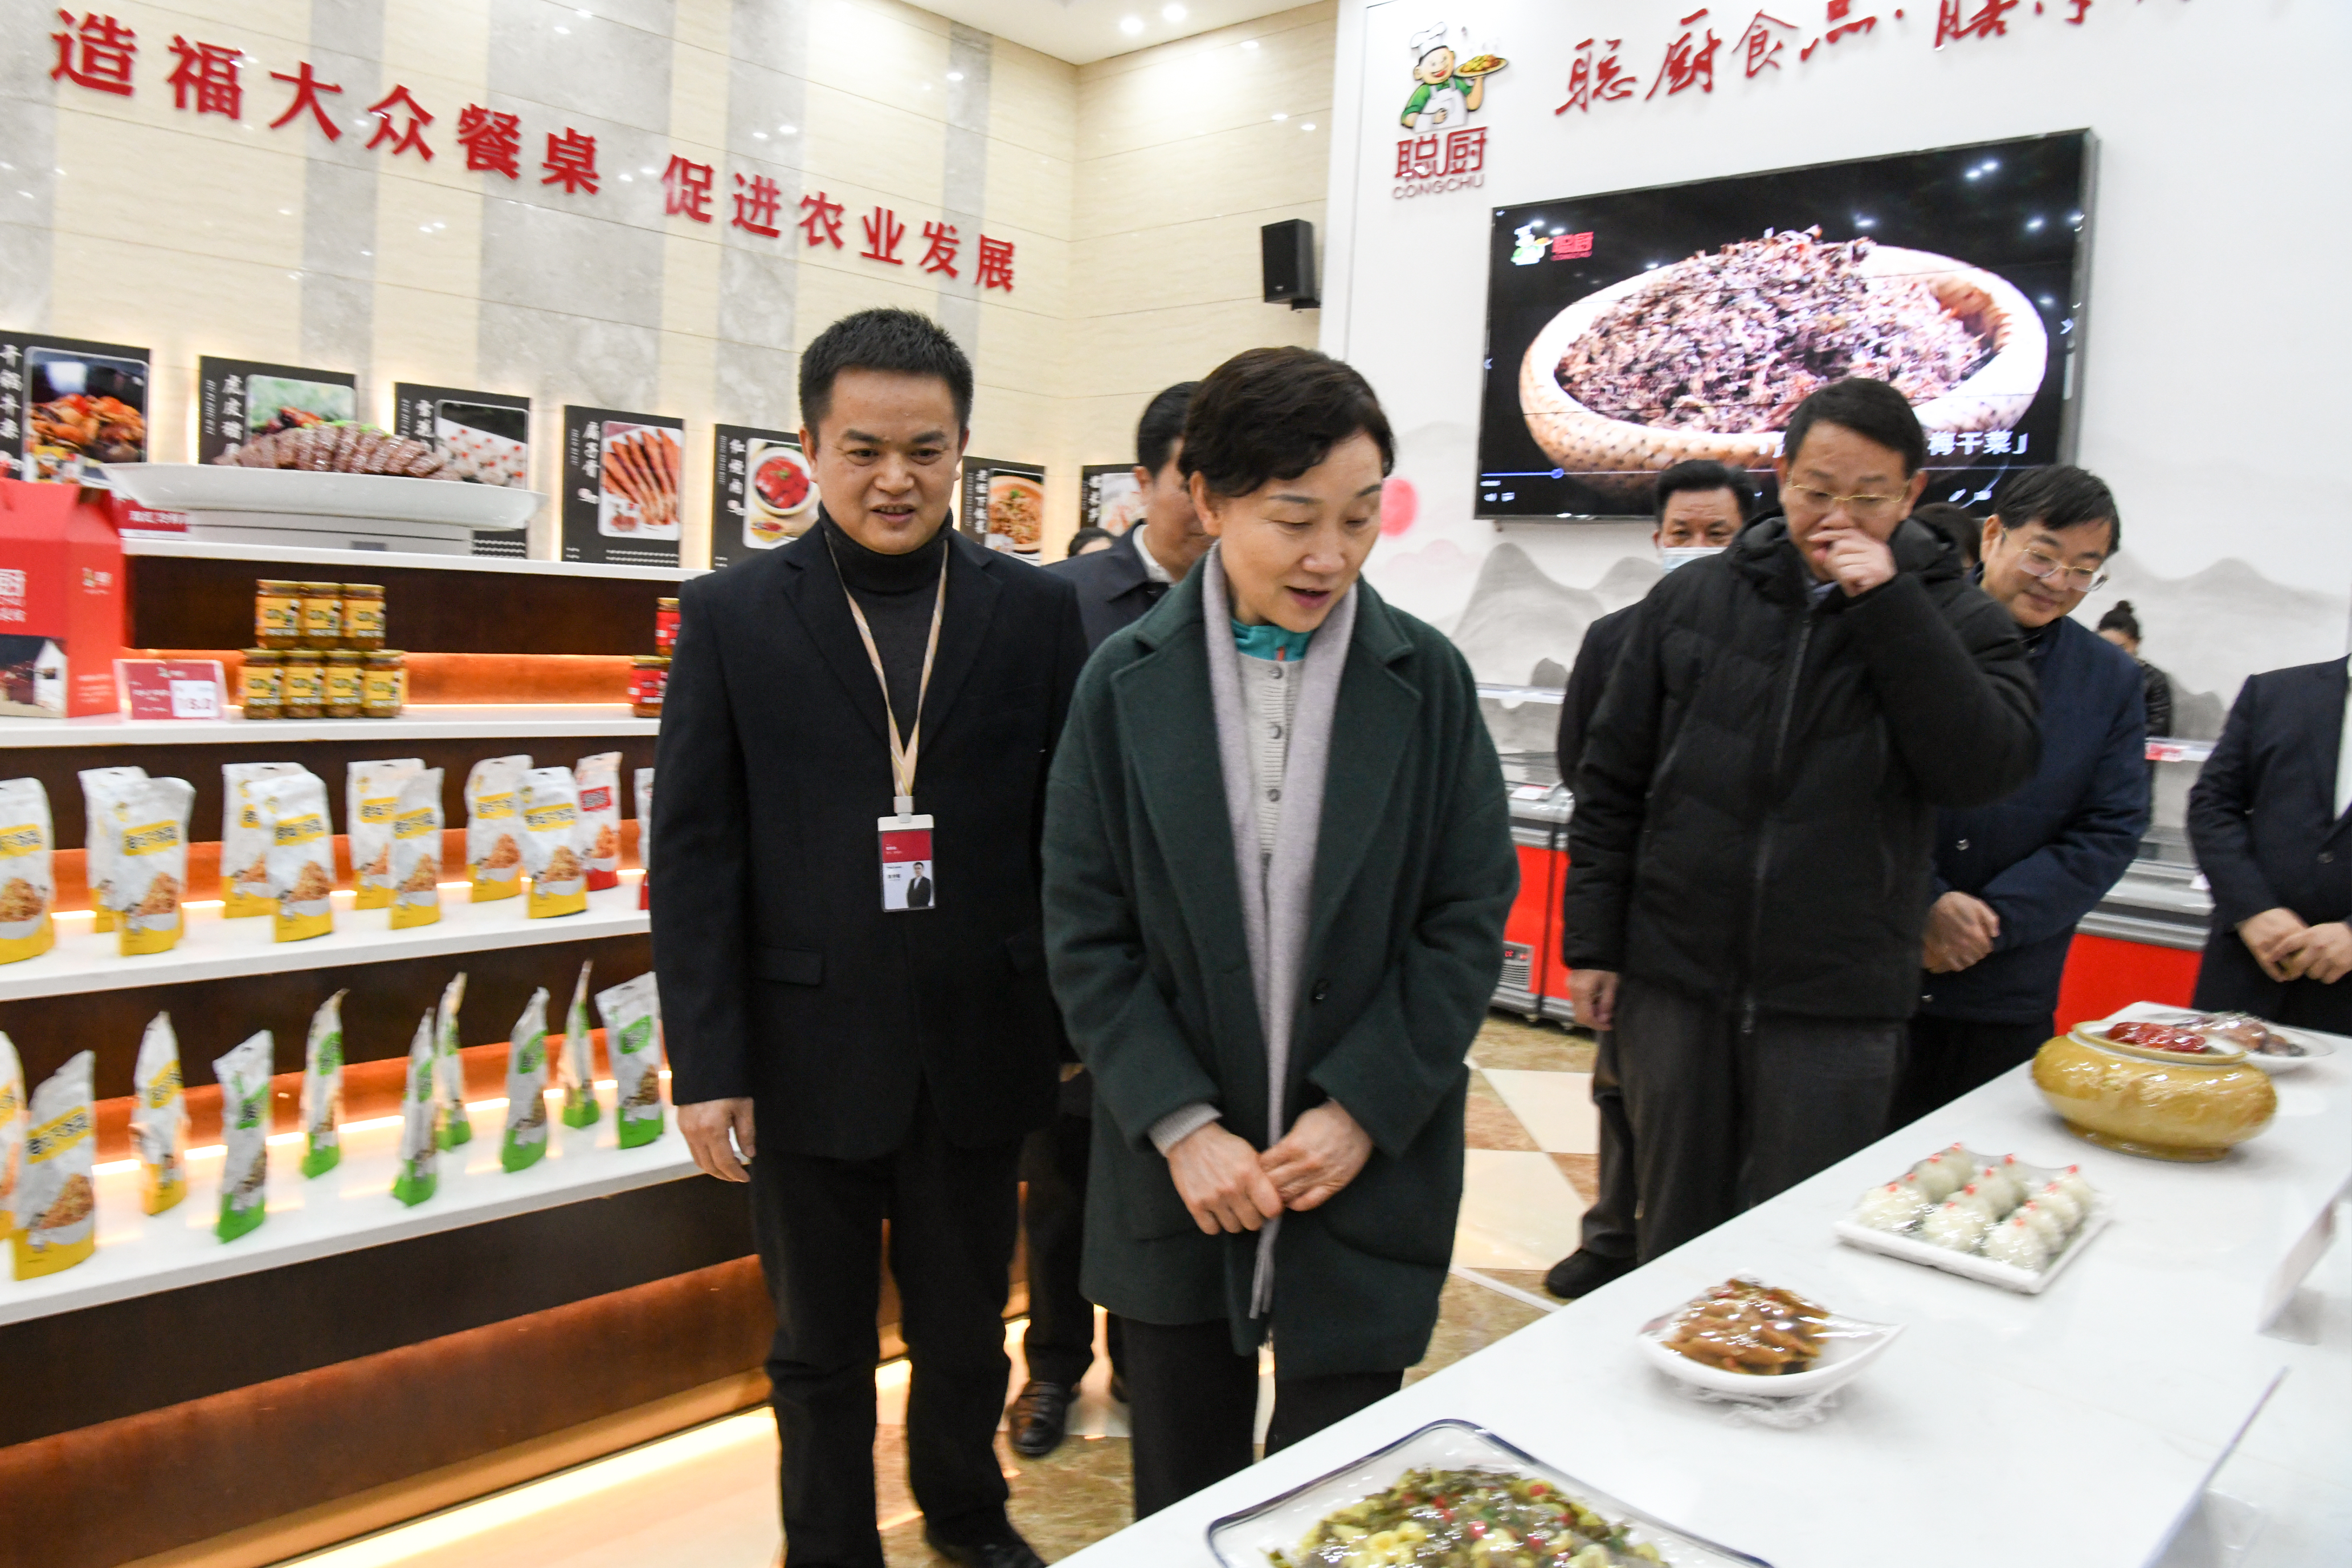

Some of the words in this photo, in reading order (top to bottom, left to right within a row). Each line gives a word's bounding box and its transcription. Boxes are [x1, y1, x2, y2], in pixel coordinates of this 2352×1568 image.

[50, 8, 600, 195] 造福大众餐桌
[1393, 173, 1484, 199] CONGCHU
[1395, 126, 1488, 181] 聪厨
[661, 153, 1015, 293] 促进农业发展
